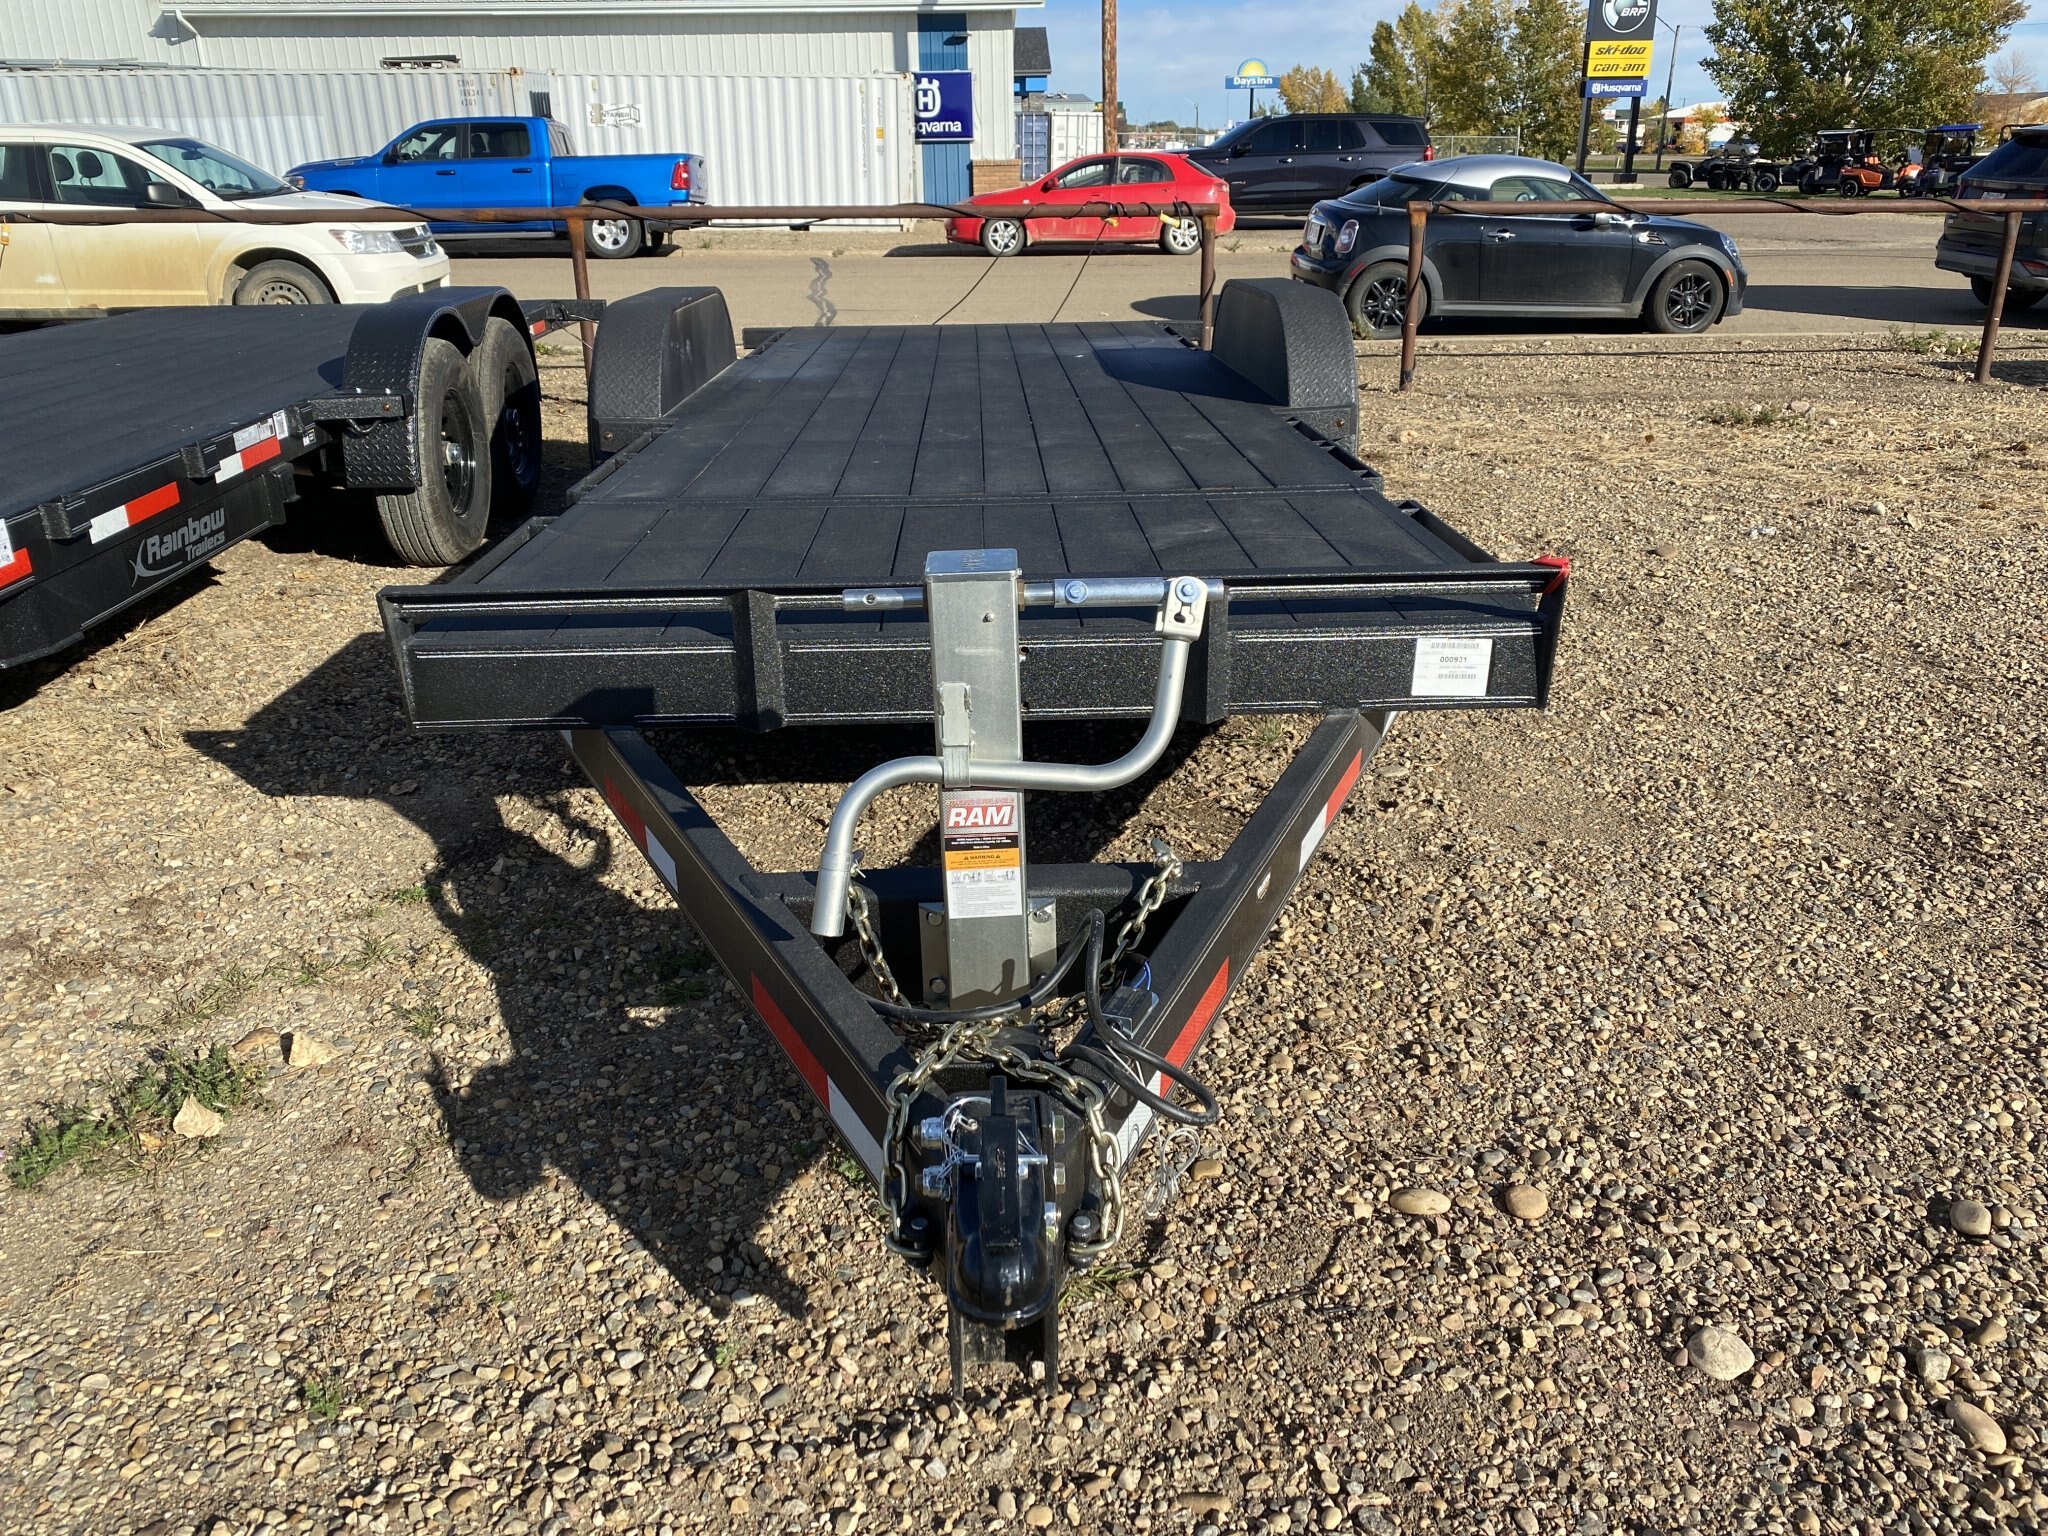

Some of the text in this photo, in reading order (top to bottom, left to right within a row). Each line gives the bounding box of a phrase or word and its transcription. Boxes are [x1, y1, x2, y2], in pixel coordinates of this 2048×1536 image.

[1620, 7, 1647, 17] BRP
[1595, 45, 1647, 56] ski-doo
[1592, 63, 1646, 72] can-am
[1233, 77, 1273, 86] Days Inn
[1600, 83, 1642, 93] Husqvarna
[590, 110, 631, 118] CNTAINER
[917, 121, 962, 134] qvarna
[146, 507, 225, 565] Rainbow
[185, 531, 226, 561] Trailers
[948, 806, 1012, 827] RAM
